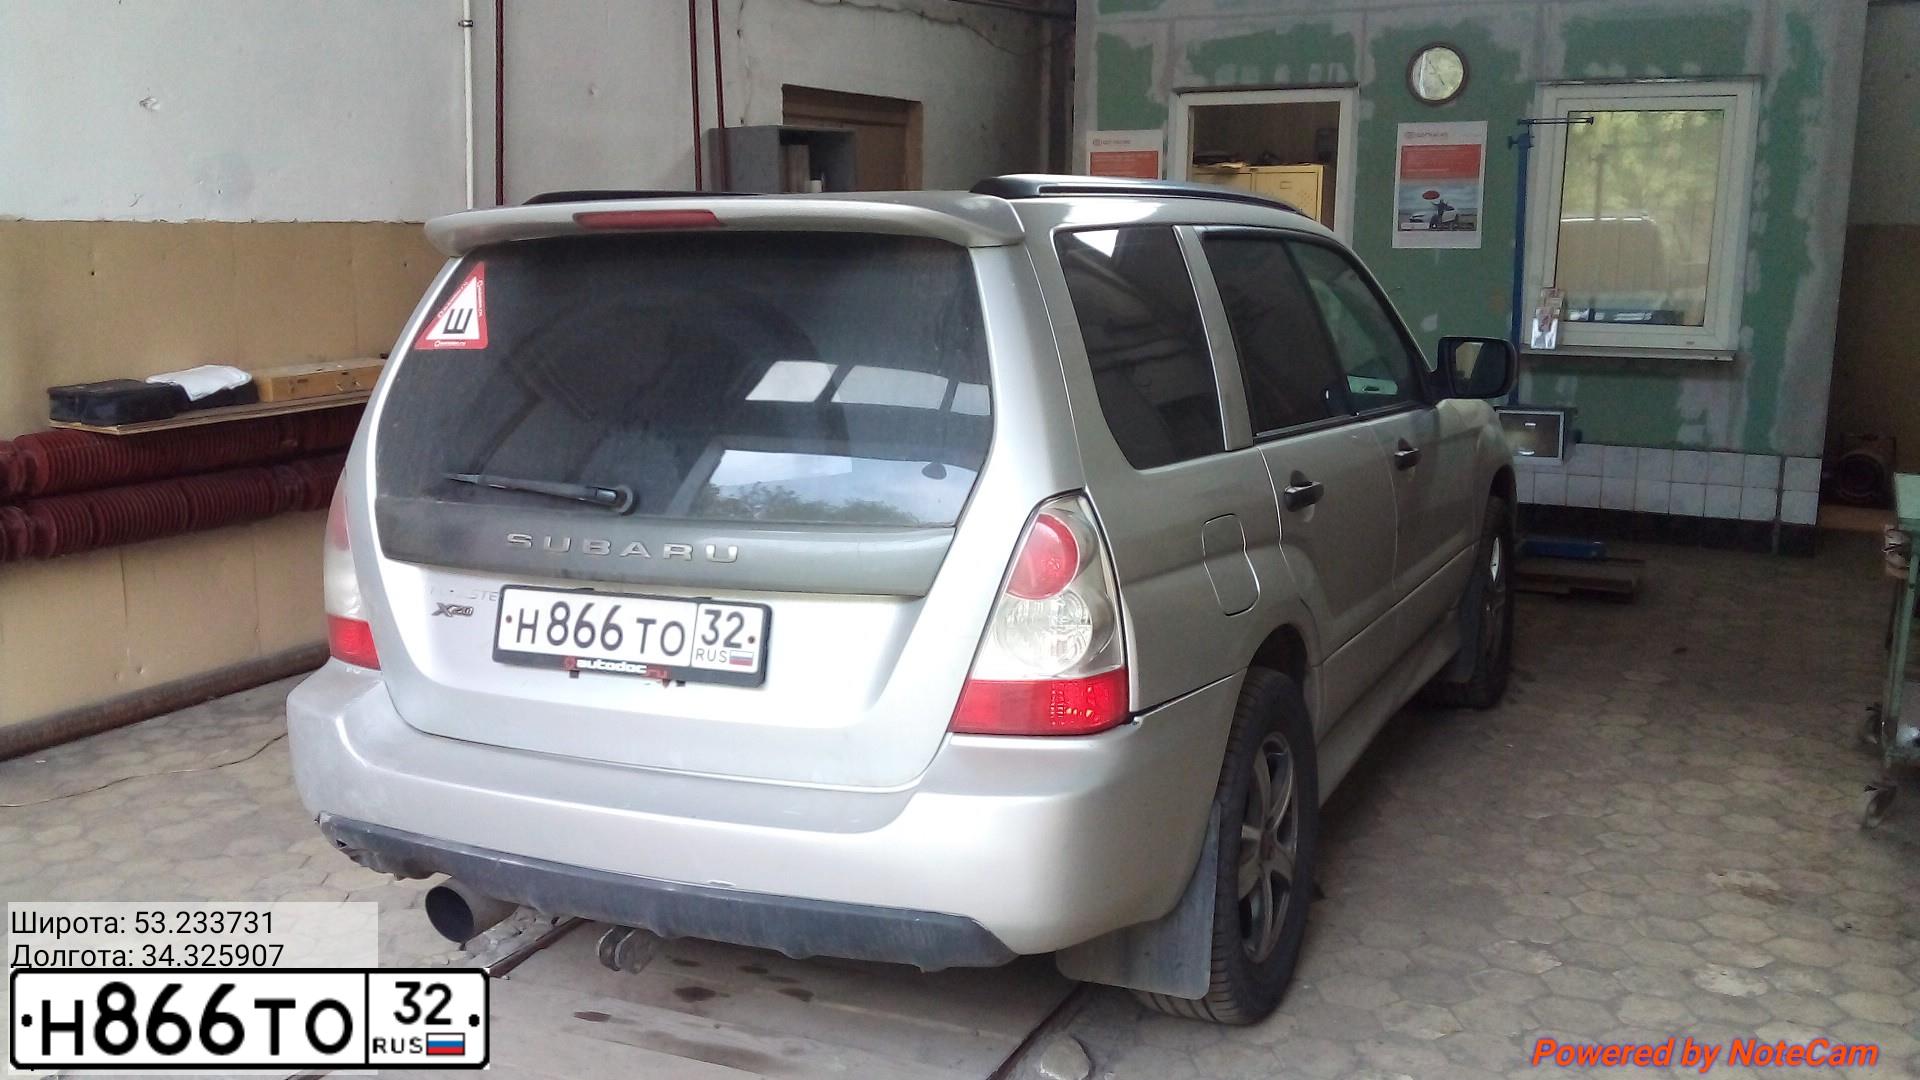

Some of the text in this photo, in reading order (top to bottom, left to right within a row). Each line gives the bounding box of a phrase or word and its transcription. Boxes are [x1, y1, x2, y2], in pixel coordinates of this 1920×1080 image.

[443, 308, 473, 334] Ш
[506, 533, 739, 563] SUBARU
[701, 609, 745, 648] 32
[696, 648, 728, 663] RUS
